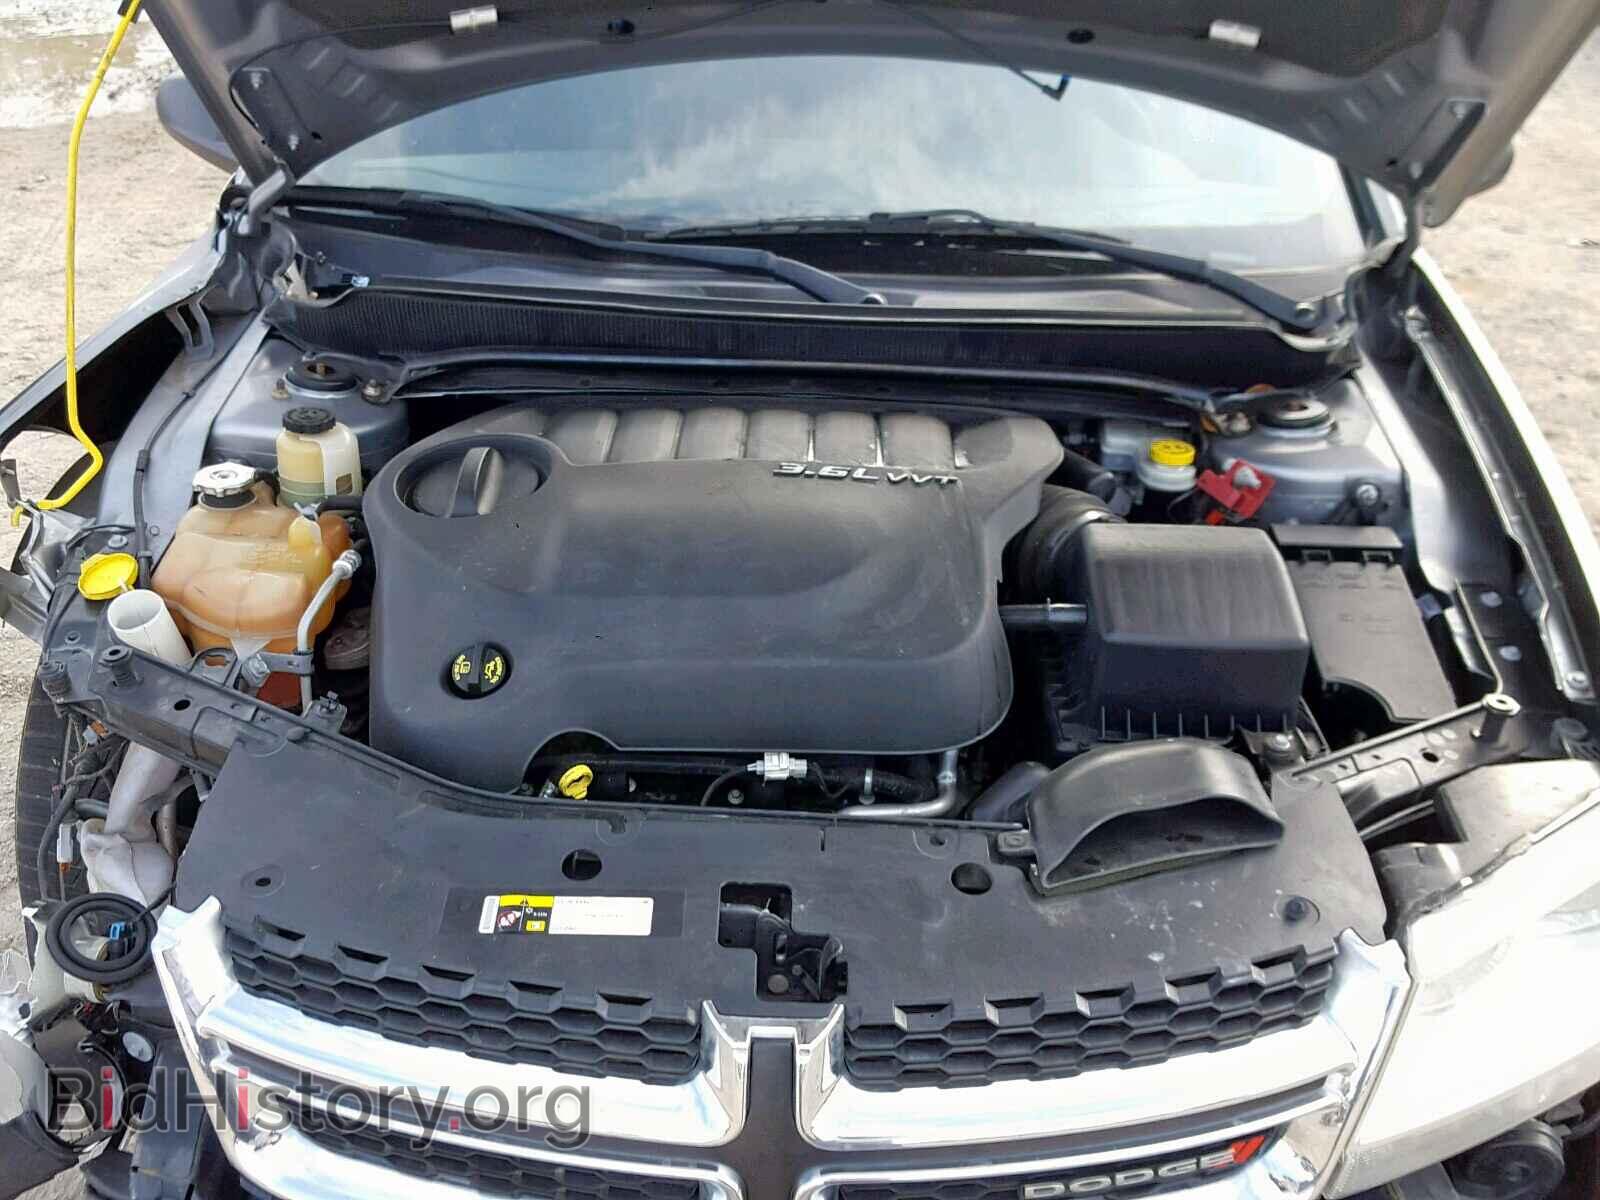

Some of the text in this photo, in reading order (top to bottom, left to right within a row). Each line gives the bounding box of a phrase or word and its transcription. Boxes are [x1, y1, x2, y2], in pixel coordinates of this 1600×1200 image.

[773, 462, 959, 485] 3.6L VVT
[1024, 1151, 1233, 1200] DODGE
